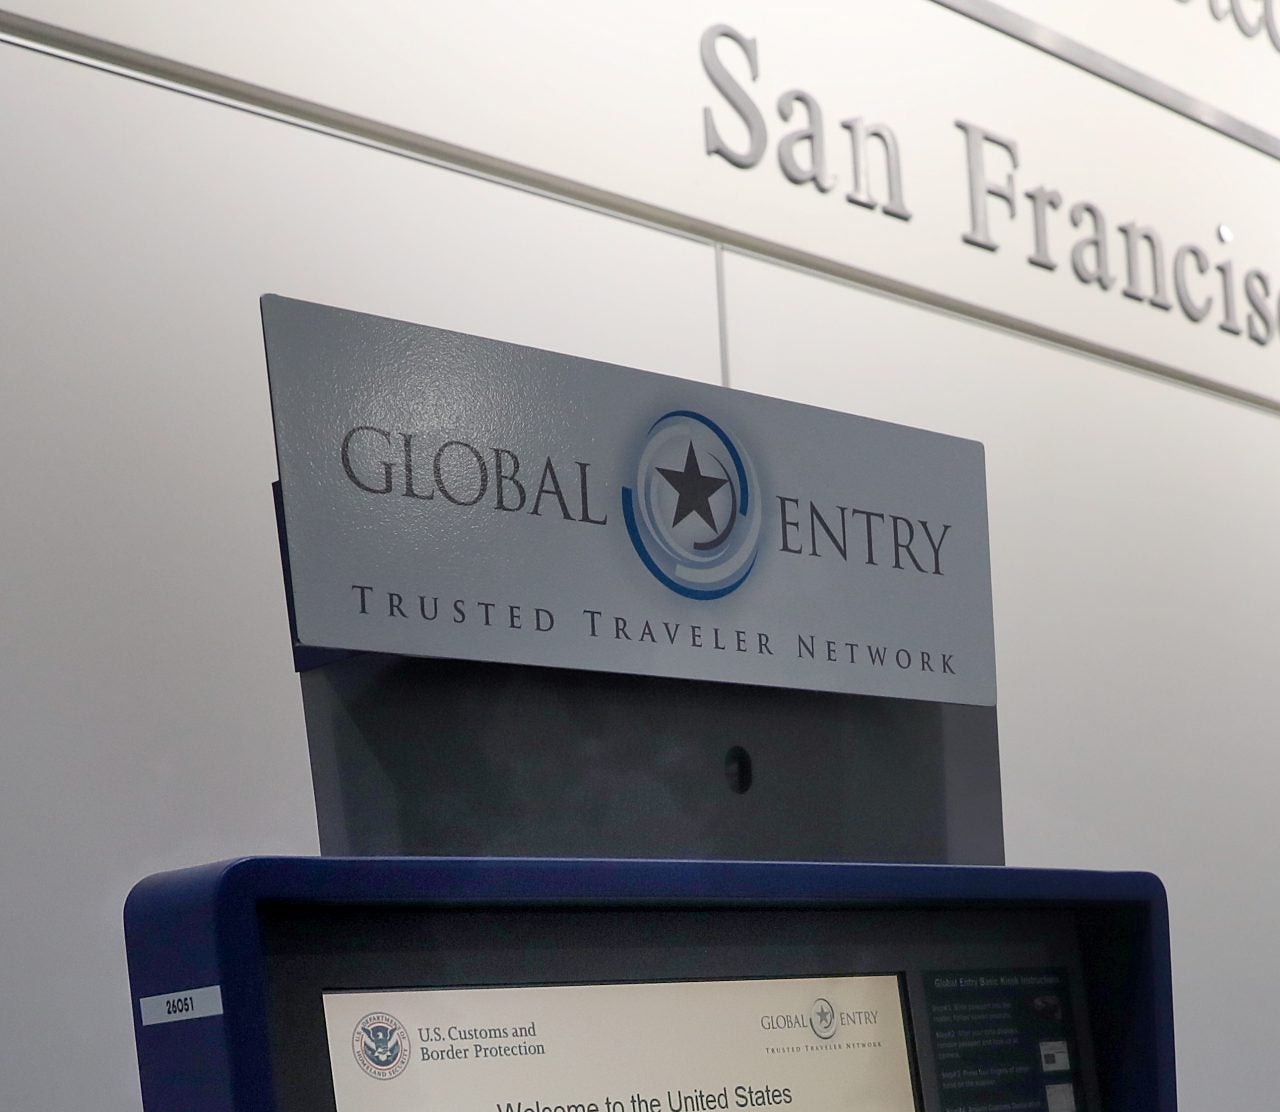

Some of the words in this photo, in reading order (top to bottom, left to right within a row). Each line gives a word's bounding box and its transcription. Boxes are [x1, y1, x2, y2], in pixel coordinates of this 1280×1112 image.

[699, 23, 912, 222] San
[341, 425, 608, 526] GLOBAL
[778, 494, 952, 576] ENTRY
[352, 585, 556, 632] TRUSTED
[582, 609, 774, 656] TRAVELER
[798, 634, 958, 675] NETWORK
[166, 997, 194, 1014] 26051
[761, 1014, 808, 1029] GLOBAL
[840, 1011, 878, 1025] ENTRY
[418, 1028, 445, 1042] U.S.
[448, 1025, 508, 1040] Customs
[512, 1022, 536, 1037] and
[421, 1046, 469, 1060] Border
[475, 1042, 545, 1057] Protection
[668, 1087, 728, 1112] United
[734, 1085, 792, 1107] States
